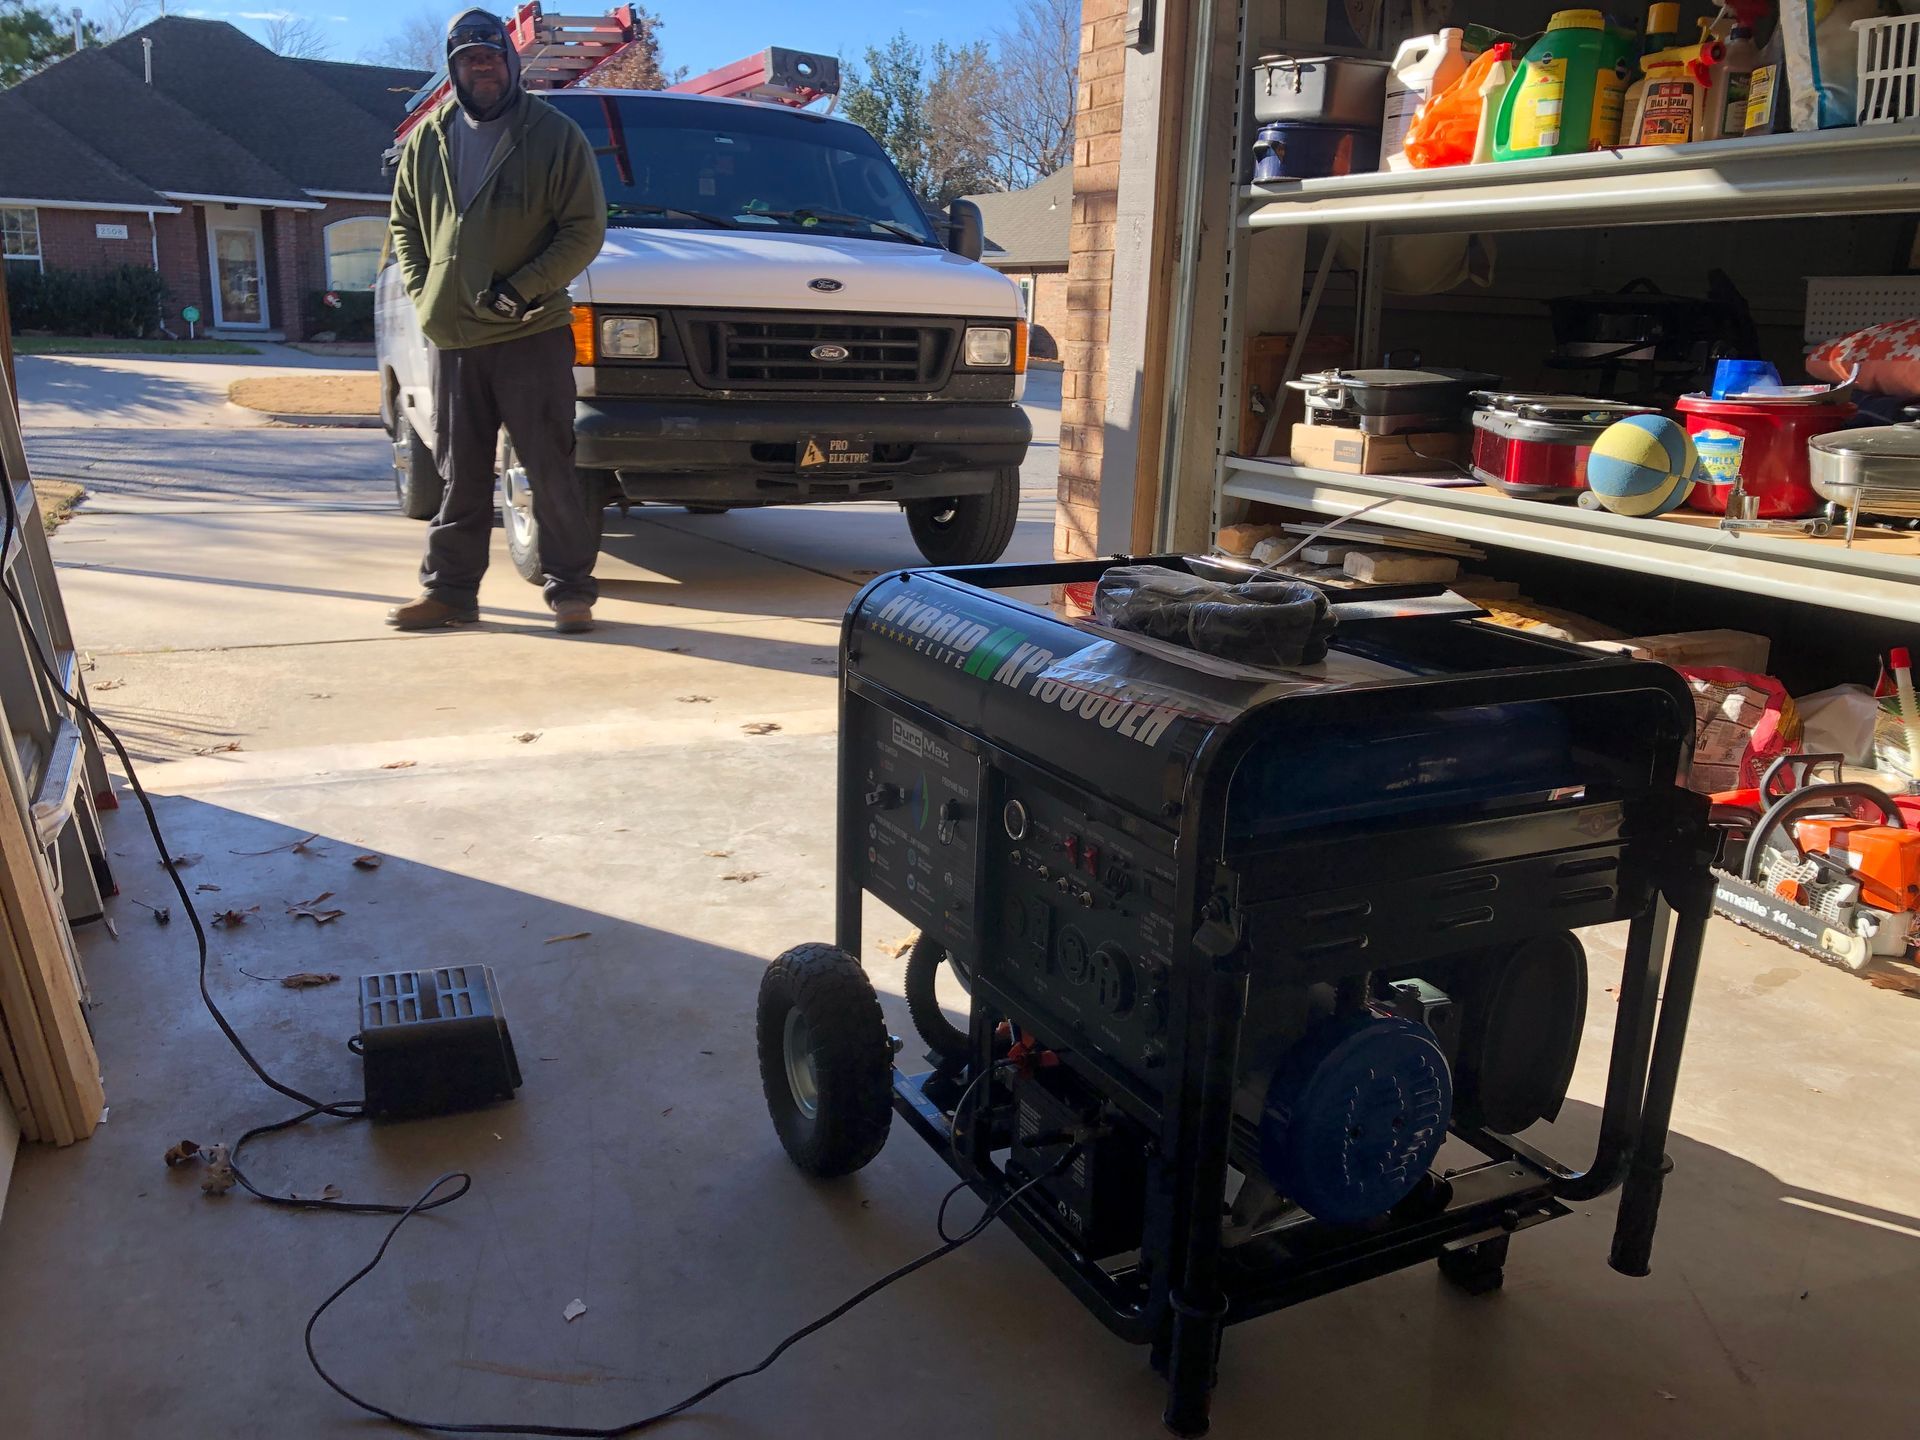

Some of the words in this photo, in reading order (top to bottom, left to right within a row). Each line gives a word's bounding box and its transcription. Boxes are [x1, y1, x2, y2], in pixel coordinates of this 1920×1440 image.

[1669, 97, 1688, 107] SPRAY
[830, 440, 848, 451] PRO
[828, 453, 869, 464] ELECTRIC
[878, 595, 990, 653] HYBRID
[914, 638, 966, 669] ELITE
[1716, 888, 1768, 917] omelite
